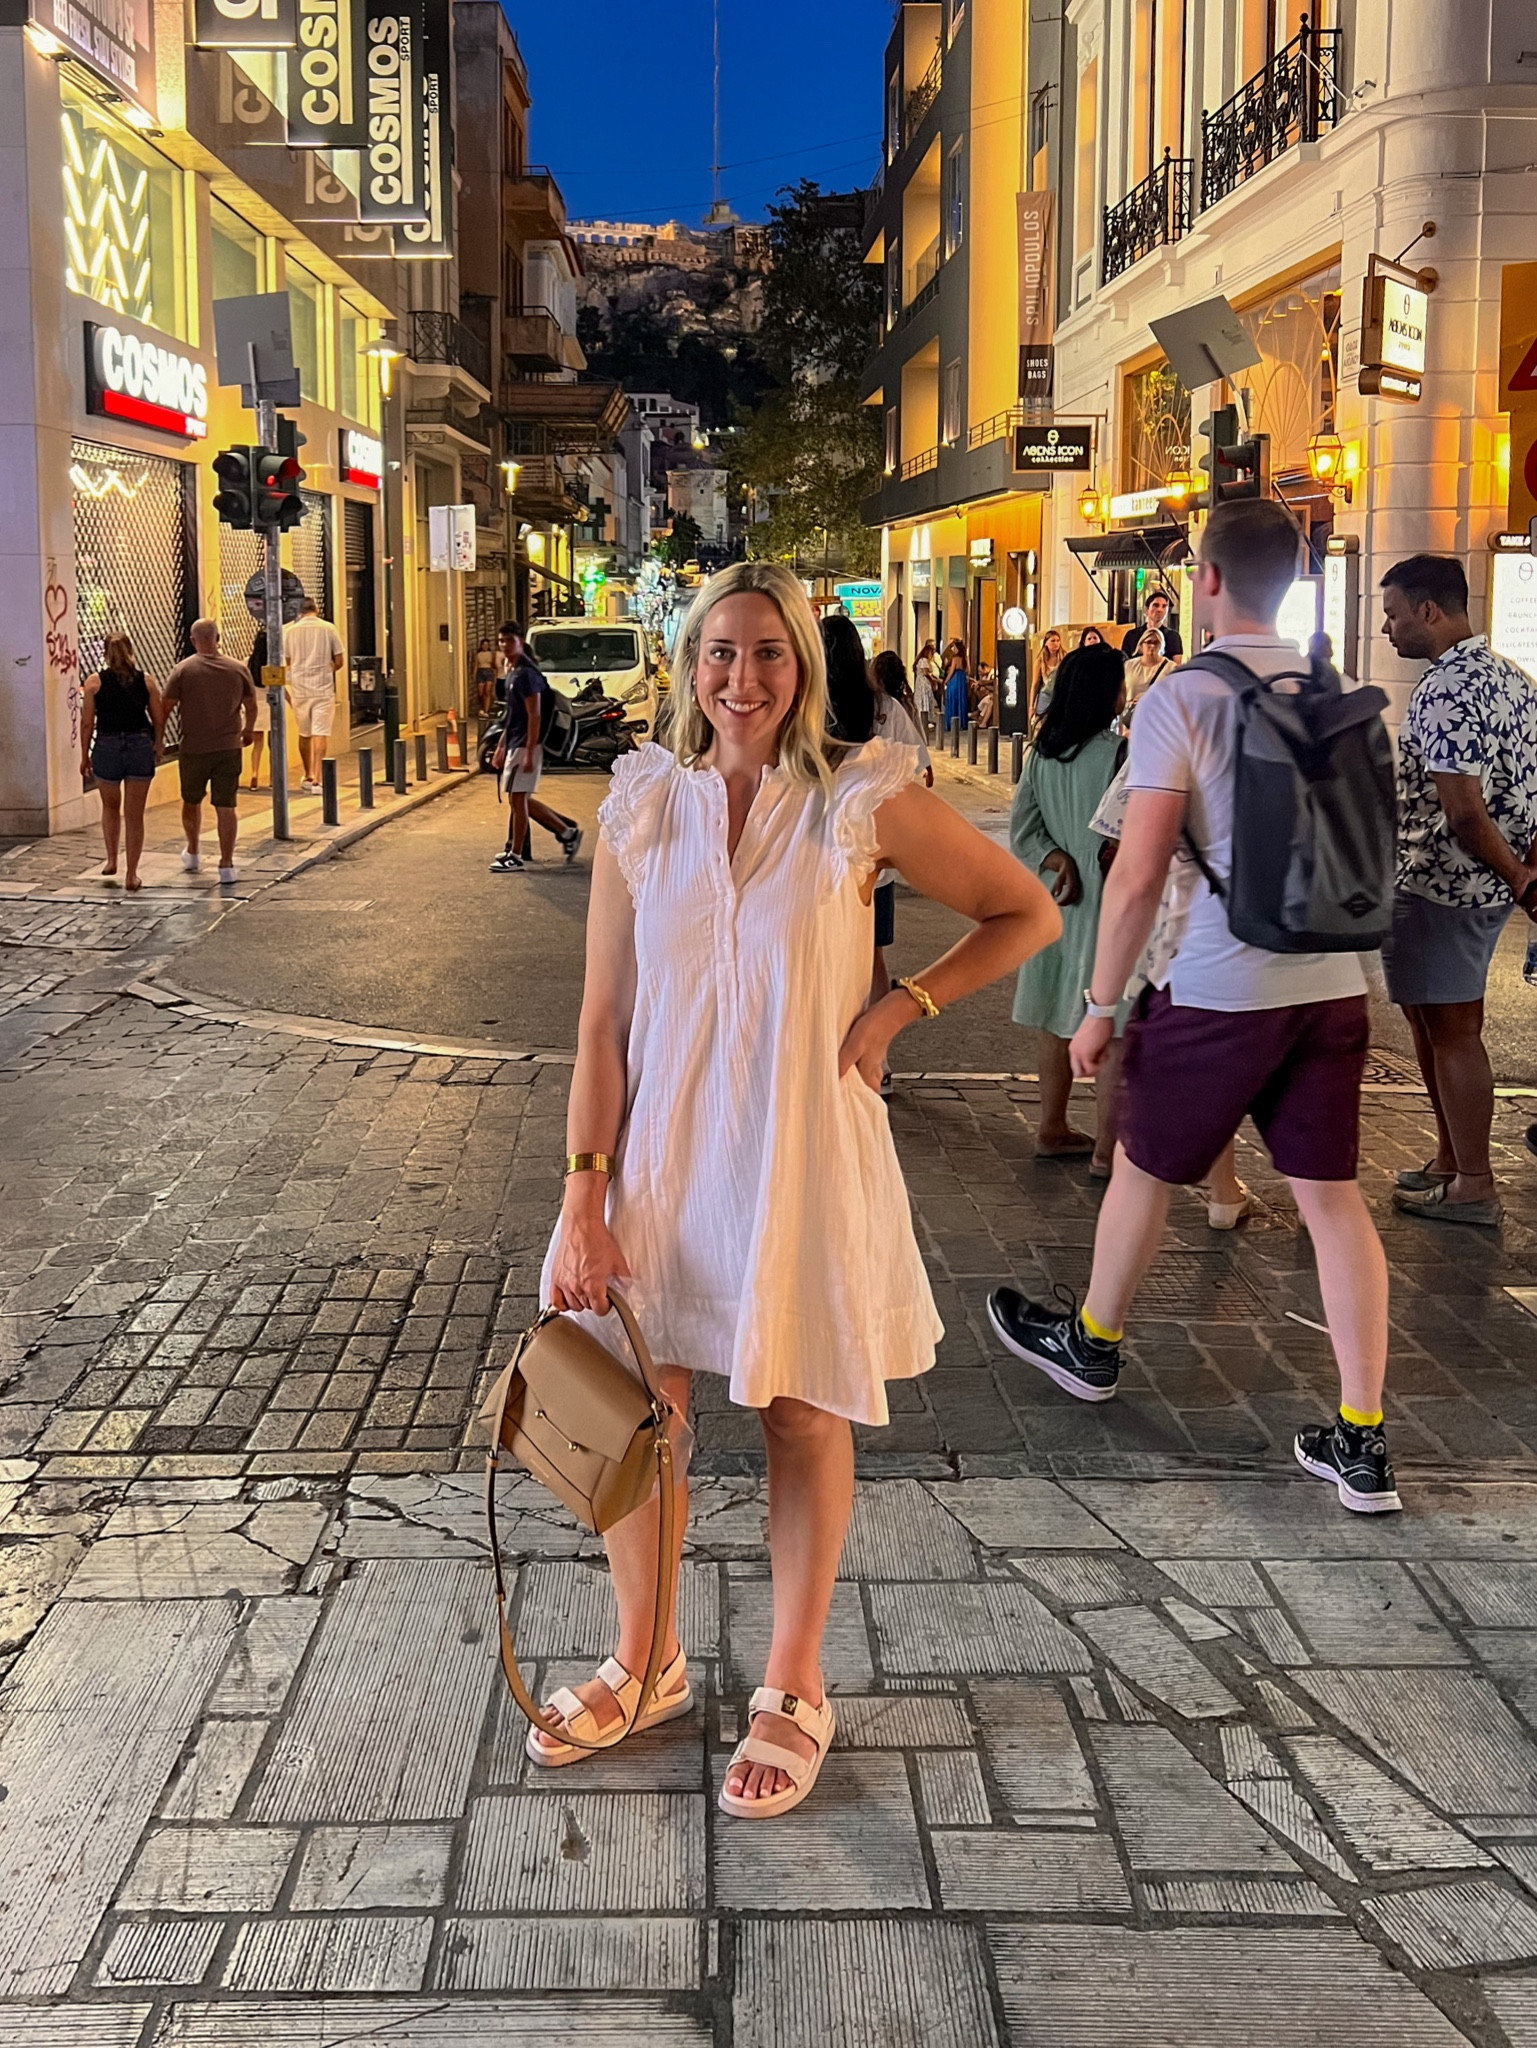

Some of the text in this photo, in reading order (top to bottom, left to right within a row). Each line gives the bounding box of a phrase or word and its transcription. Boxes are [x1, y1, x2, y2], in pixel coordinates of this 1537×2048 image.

[400, 19, 410, 61] SPORT
[368, 16, 402, 205] COSMOS
[429, 76, 438, 114] SPORT
[102, 326, 208, 418] COSMOS
[1026, 358, 1049, 368] SHOES
[1027, 370, 1047, 379] BAGS
[1057, 445, 1084, 456] ICON
